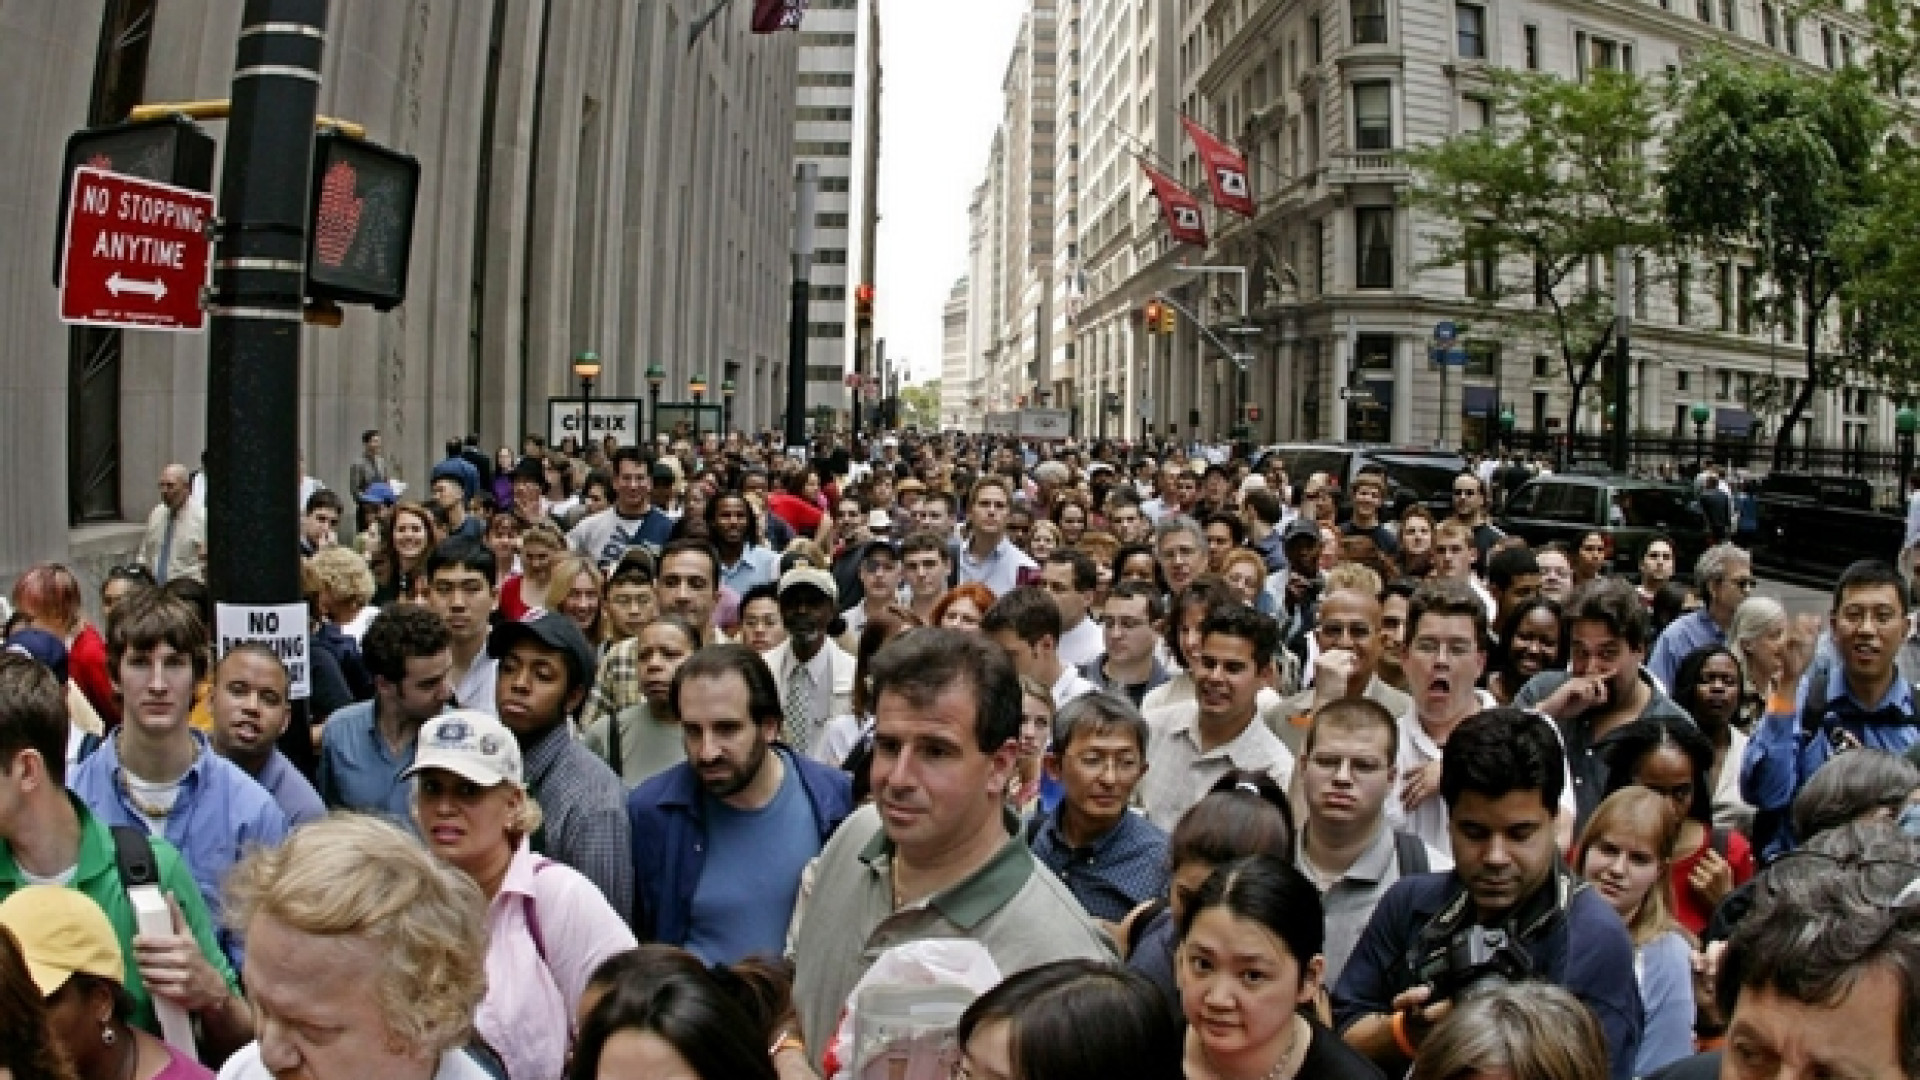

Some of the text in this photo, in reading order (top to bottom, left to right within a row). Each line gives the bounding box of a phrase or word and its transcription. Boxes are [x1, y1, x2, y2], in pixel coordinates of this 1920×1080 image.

[83, 185, 204, 233] NO STOPPING
[93, 229, 186, 269] ANYTIME
[248, 610, 279, 635] NO
